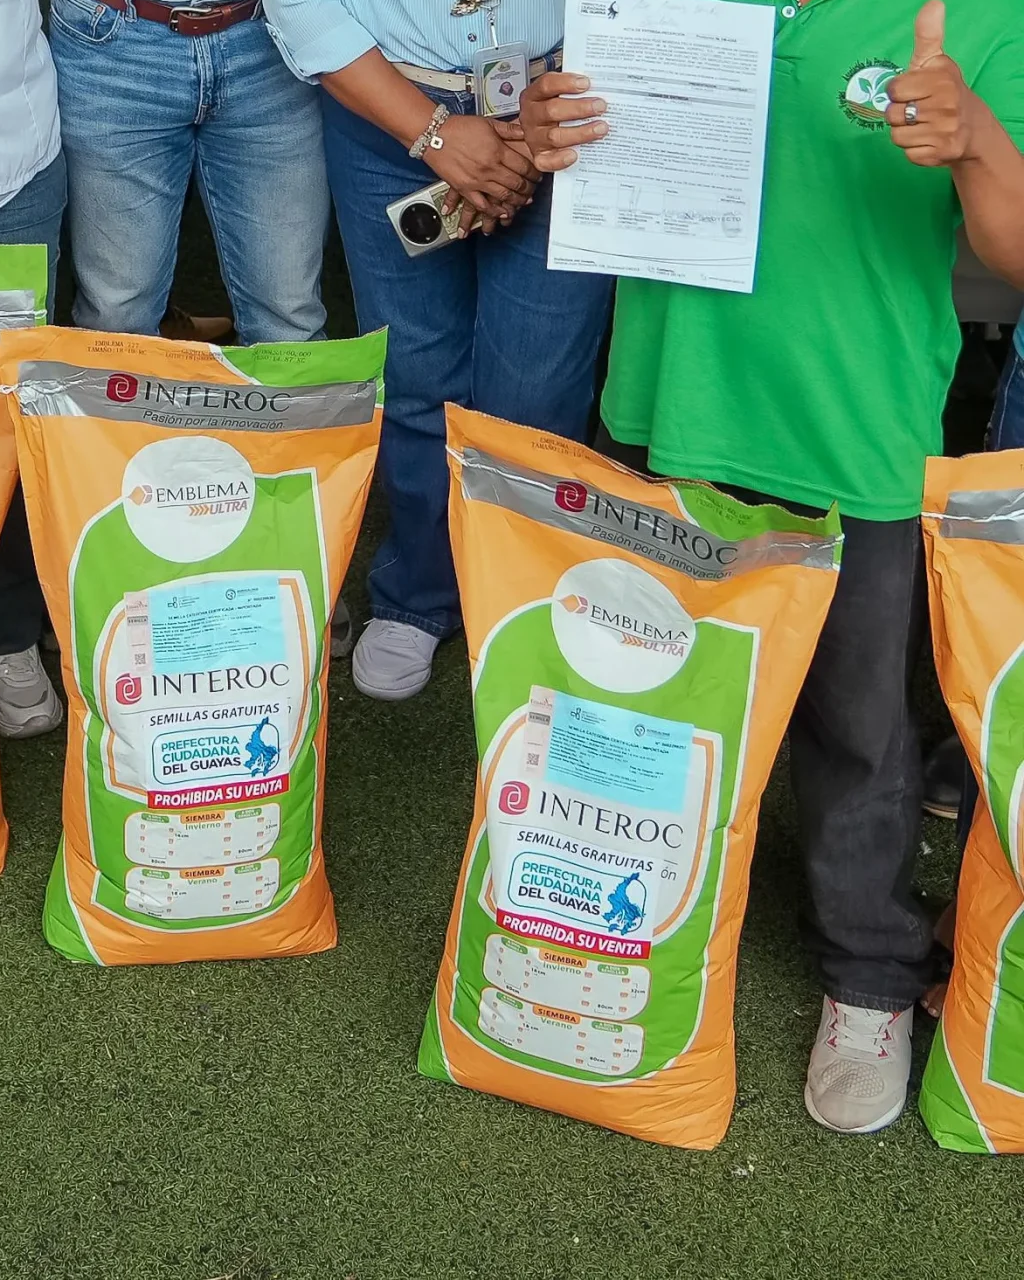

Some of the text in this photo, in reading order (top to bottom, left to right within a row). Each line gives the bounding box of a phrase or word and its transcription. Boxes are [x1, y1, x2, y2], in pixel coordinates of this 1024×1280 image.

[145, 380, 291, 413] INTEROC
[142, 410, 286, 429] Pasión por la innovación.
[156, 481, 248, 503] EMBLEMA
[210, 501, 248, 516] ULTRA
[593, 496, 739, 566] INTEROC
[590, 525, 735, 580] Pasión por la innovación.
[590, 605, 690, 640] EMBLEMA
[644, 641, 686, 657] ULTRA
[152, 663, 290, 697] INTEROC
[149, 703, 280, 727] SEMILLAS GRATUITAS
[161, 736, 239, 751] PREFECTURA
[162, 745, 240, 763] CIUDADANA
[163, 757, 242, 775] DEL GUAYAS
[154, 780, 283, 806] PROHIBIDA SU VENTA
[185, 814, 221, 822] SIEMBRA
[185, 822, 221, 830] Invierno
[539, 791, 684, 849] INTEROC
[517, 830, 654, 872] SEMILLAS GRATUITAS
[521, 874, 601, 903] CIUDADANA
[522, 862, 603, 891] PREFECTURA
[518, 886, 601, 915] DEL GUAYAS
[502, 916, 643, 955] PROHIBIDA SU VENTA
[544, 953, 583, 967] SIEMBRA
[538, 1008, 577, 1022] SIEMBRA
[540, 1017, 573, 1030] Verano
